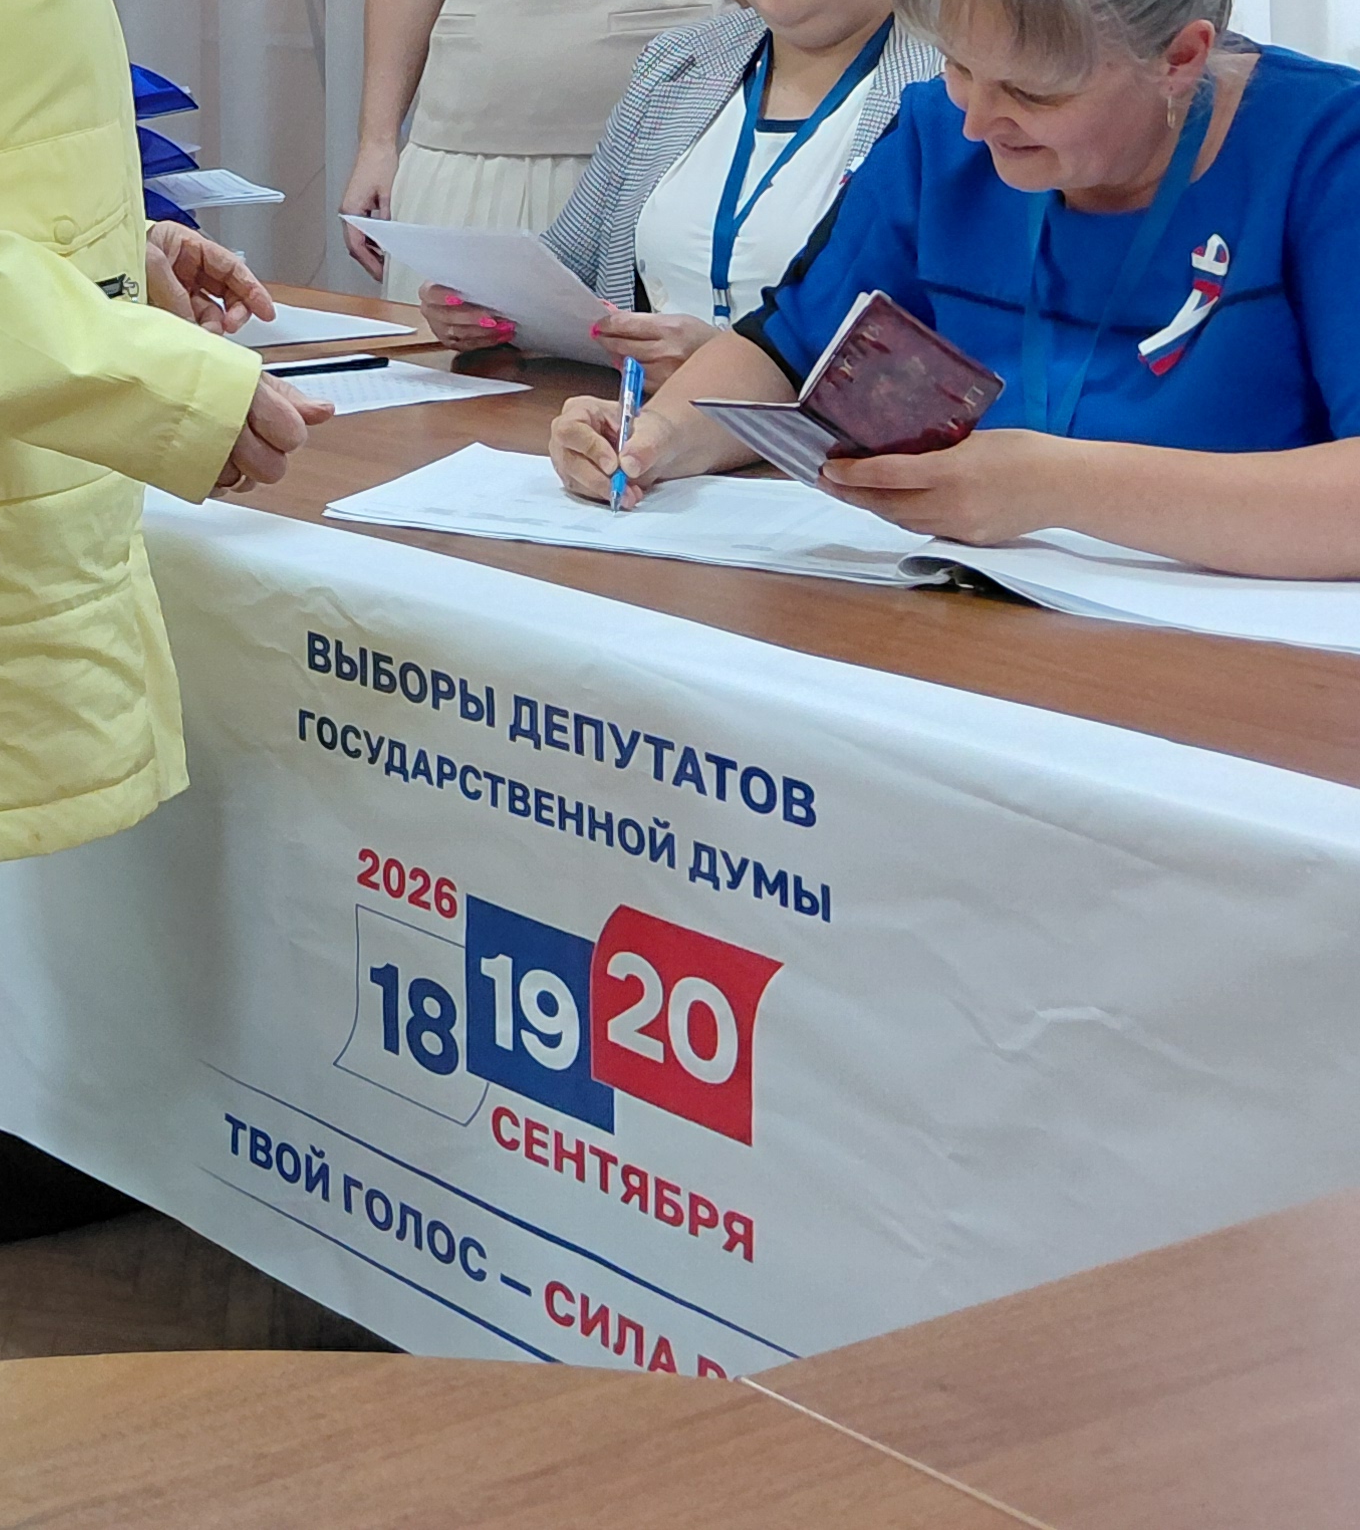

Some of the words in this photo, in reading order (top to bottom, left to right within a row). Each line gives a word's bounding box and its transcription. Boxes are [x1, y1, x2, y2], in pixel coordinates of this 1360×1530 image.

[297, 708, 677, 871] ГОСУДАРСТВЕННОЙ
[687, 837, 832, 923] ДУМЫ
[306, 629, 496, 728] ВЫБОРЫ
[508, 694, 818, 829] ДЕПУТАТОВ
[356, 847, 459, 920] 2026
[369, 961, 460, 1076] 18
[480, 953, 580, 1071] 19
[606, 950, 739, 1085] 20
[223, 1113, 332, 1203] ТВОЙ
[343, 1170, 489, 1283] ГОЛОС
[543, 1279, 679, 1375] СИЛА
[490, 1105, 755, 1264] СЕНТЯБРЯ
